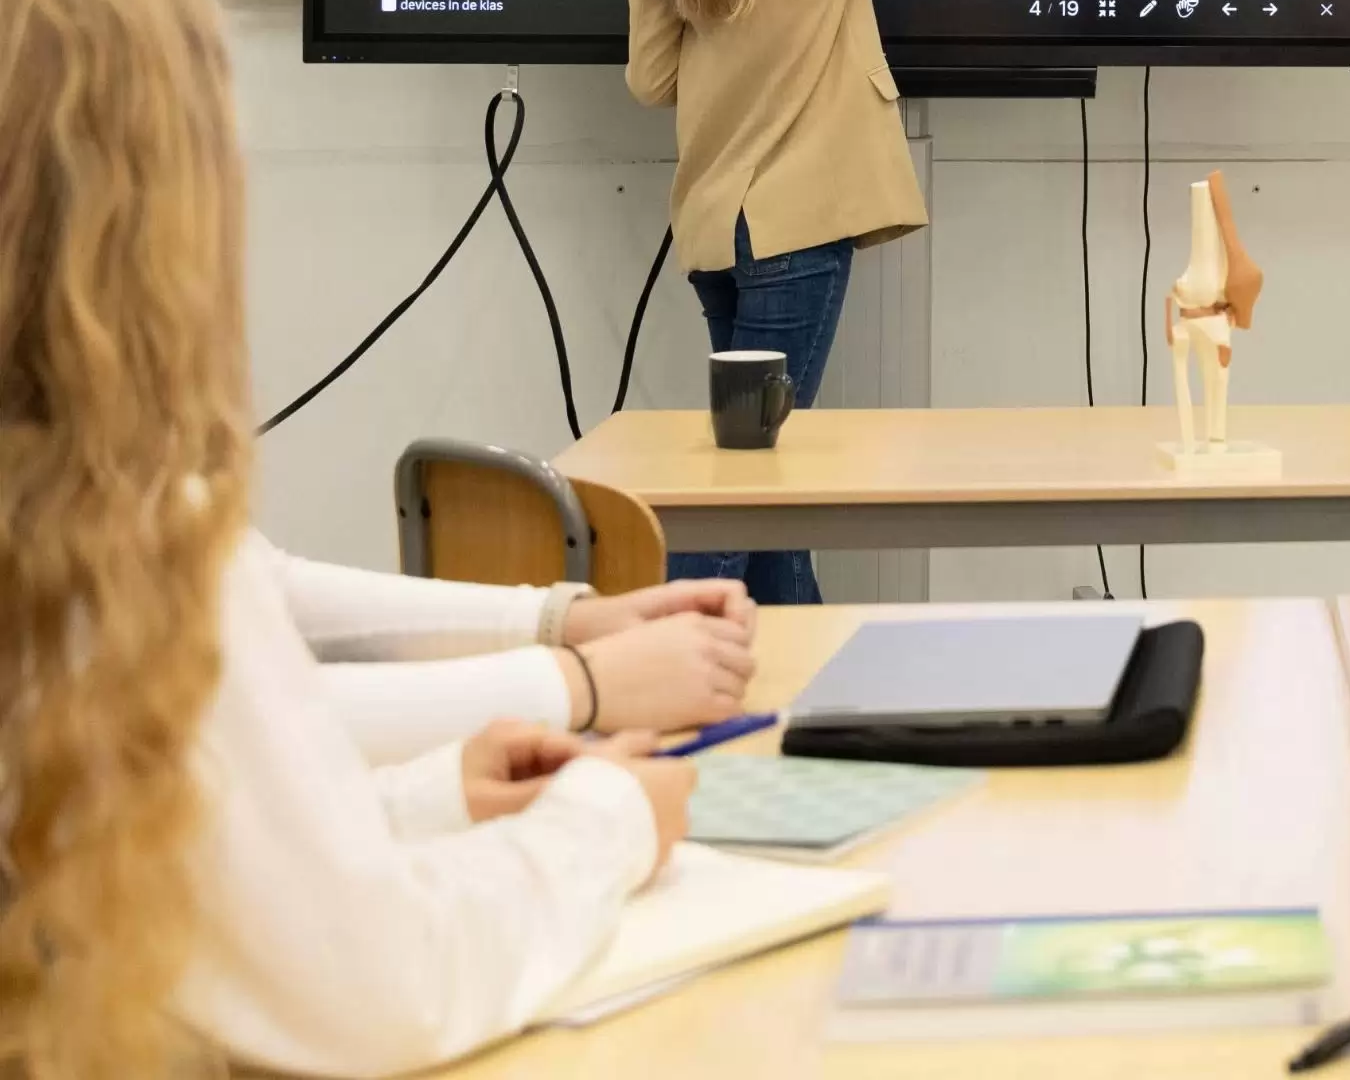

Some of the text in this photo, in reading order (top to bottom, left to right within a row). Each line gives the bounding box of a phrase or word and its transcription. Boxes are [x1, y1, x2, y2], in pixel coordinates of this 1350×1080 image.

[400, 0, 446, 11] devices
[461, 0, 477, 11] de
[479, 0, 504, 11] klas
[1029, 0, 1042, 16] 4
[1058, 0, 1080, 17] 19
